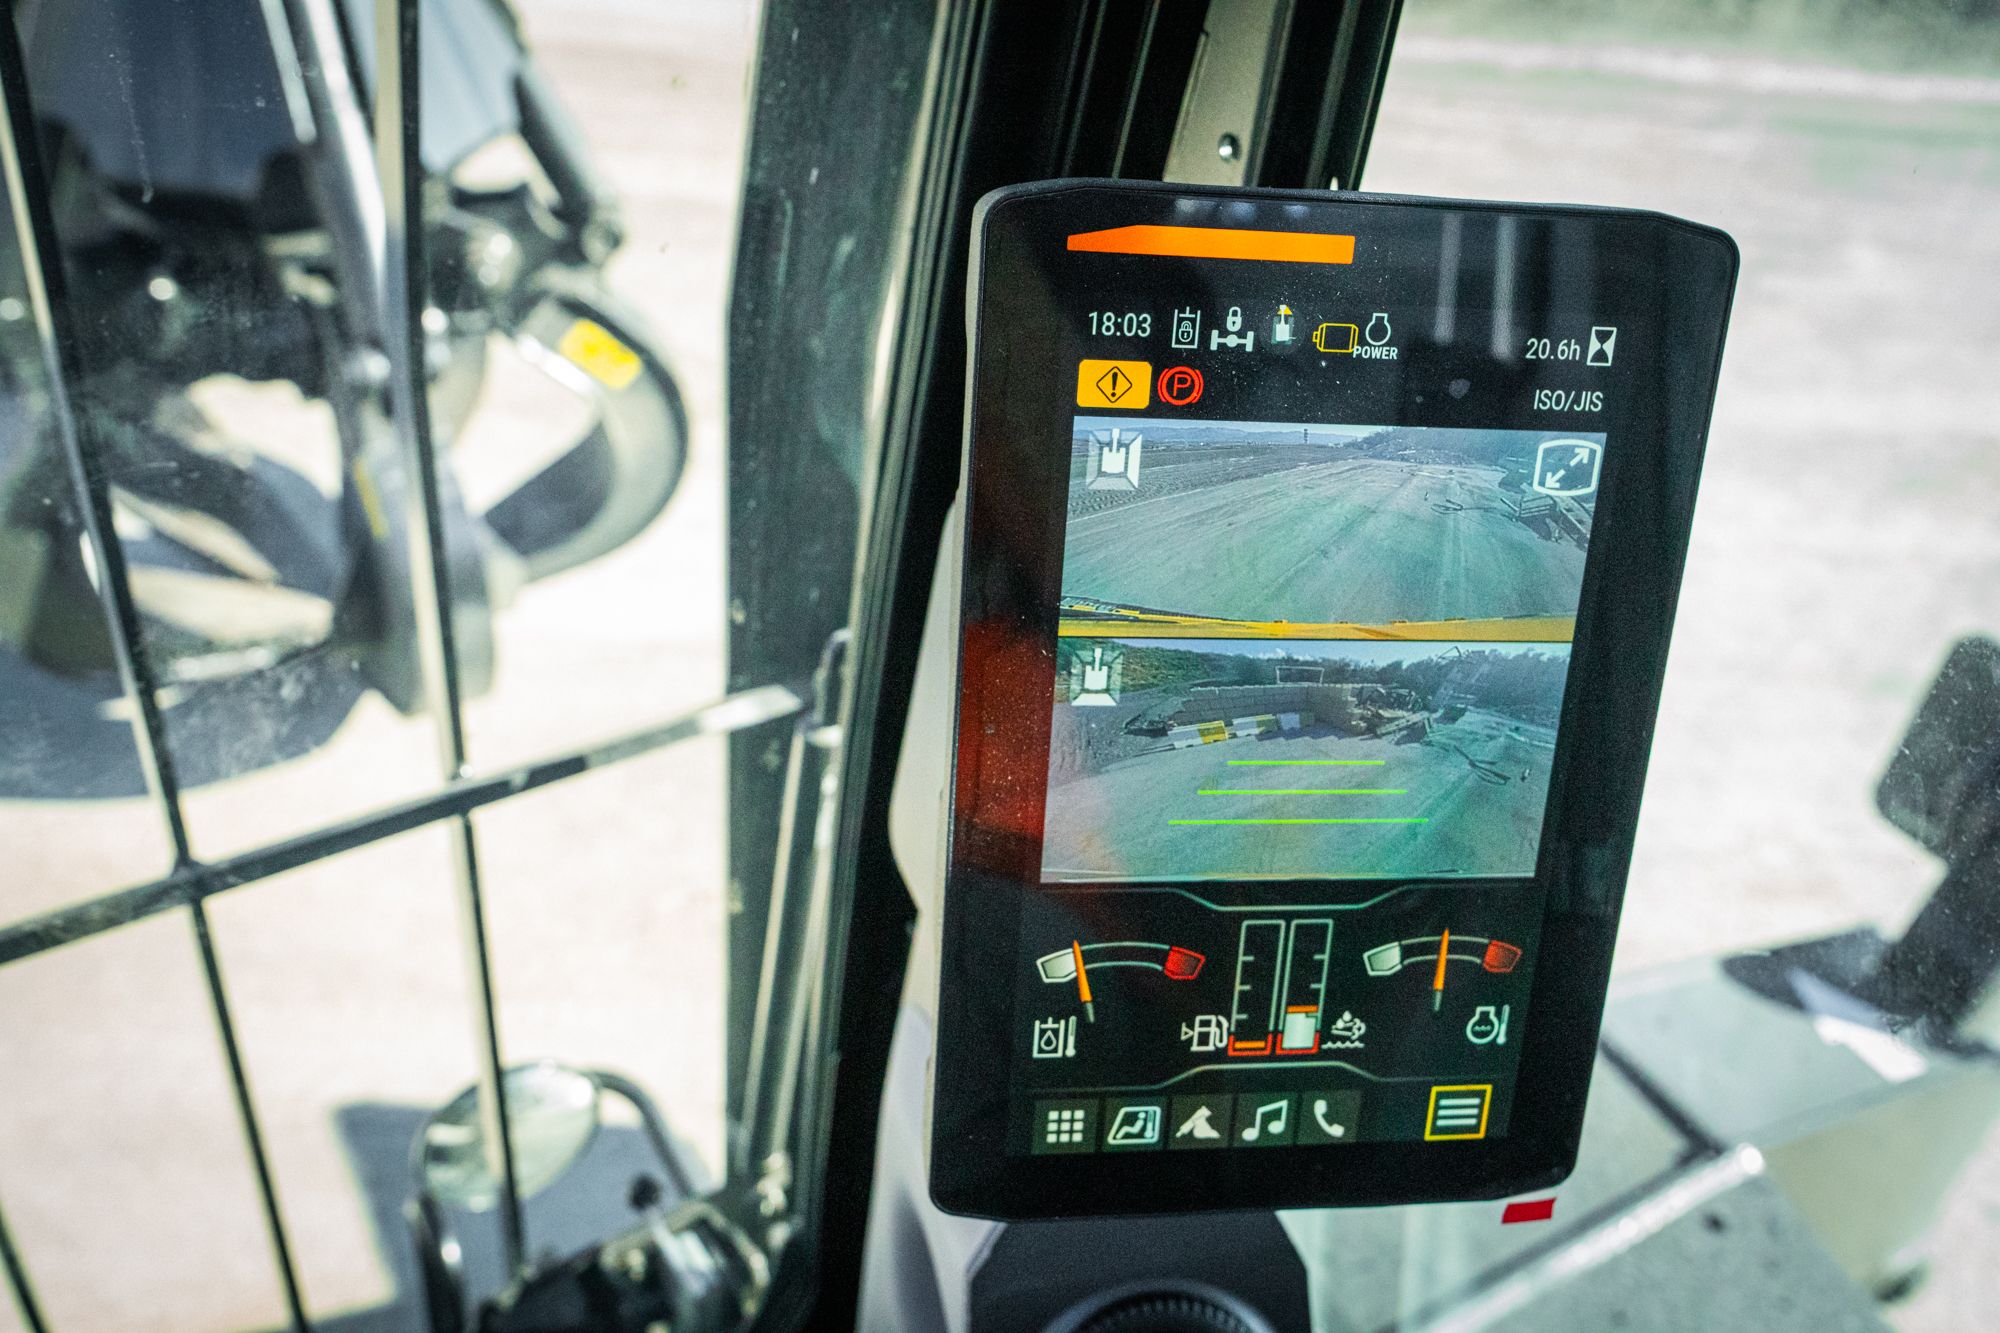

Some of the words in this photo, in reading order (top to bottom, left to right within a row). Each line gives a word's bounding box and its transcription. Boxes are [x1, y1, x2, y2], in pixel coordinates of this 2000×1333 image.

[1087, 311, 1152, 338] 18:03
[1352, 345, 1398, 360] POWER
[1525, 338, 1580, 361] 20.6h
[1173, 373, 1192, 397] P
[1533, 389, 1603, 412] ISO/JIS
